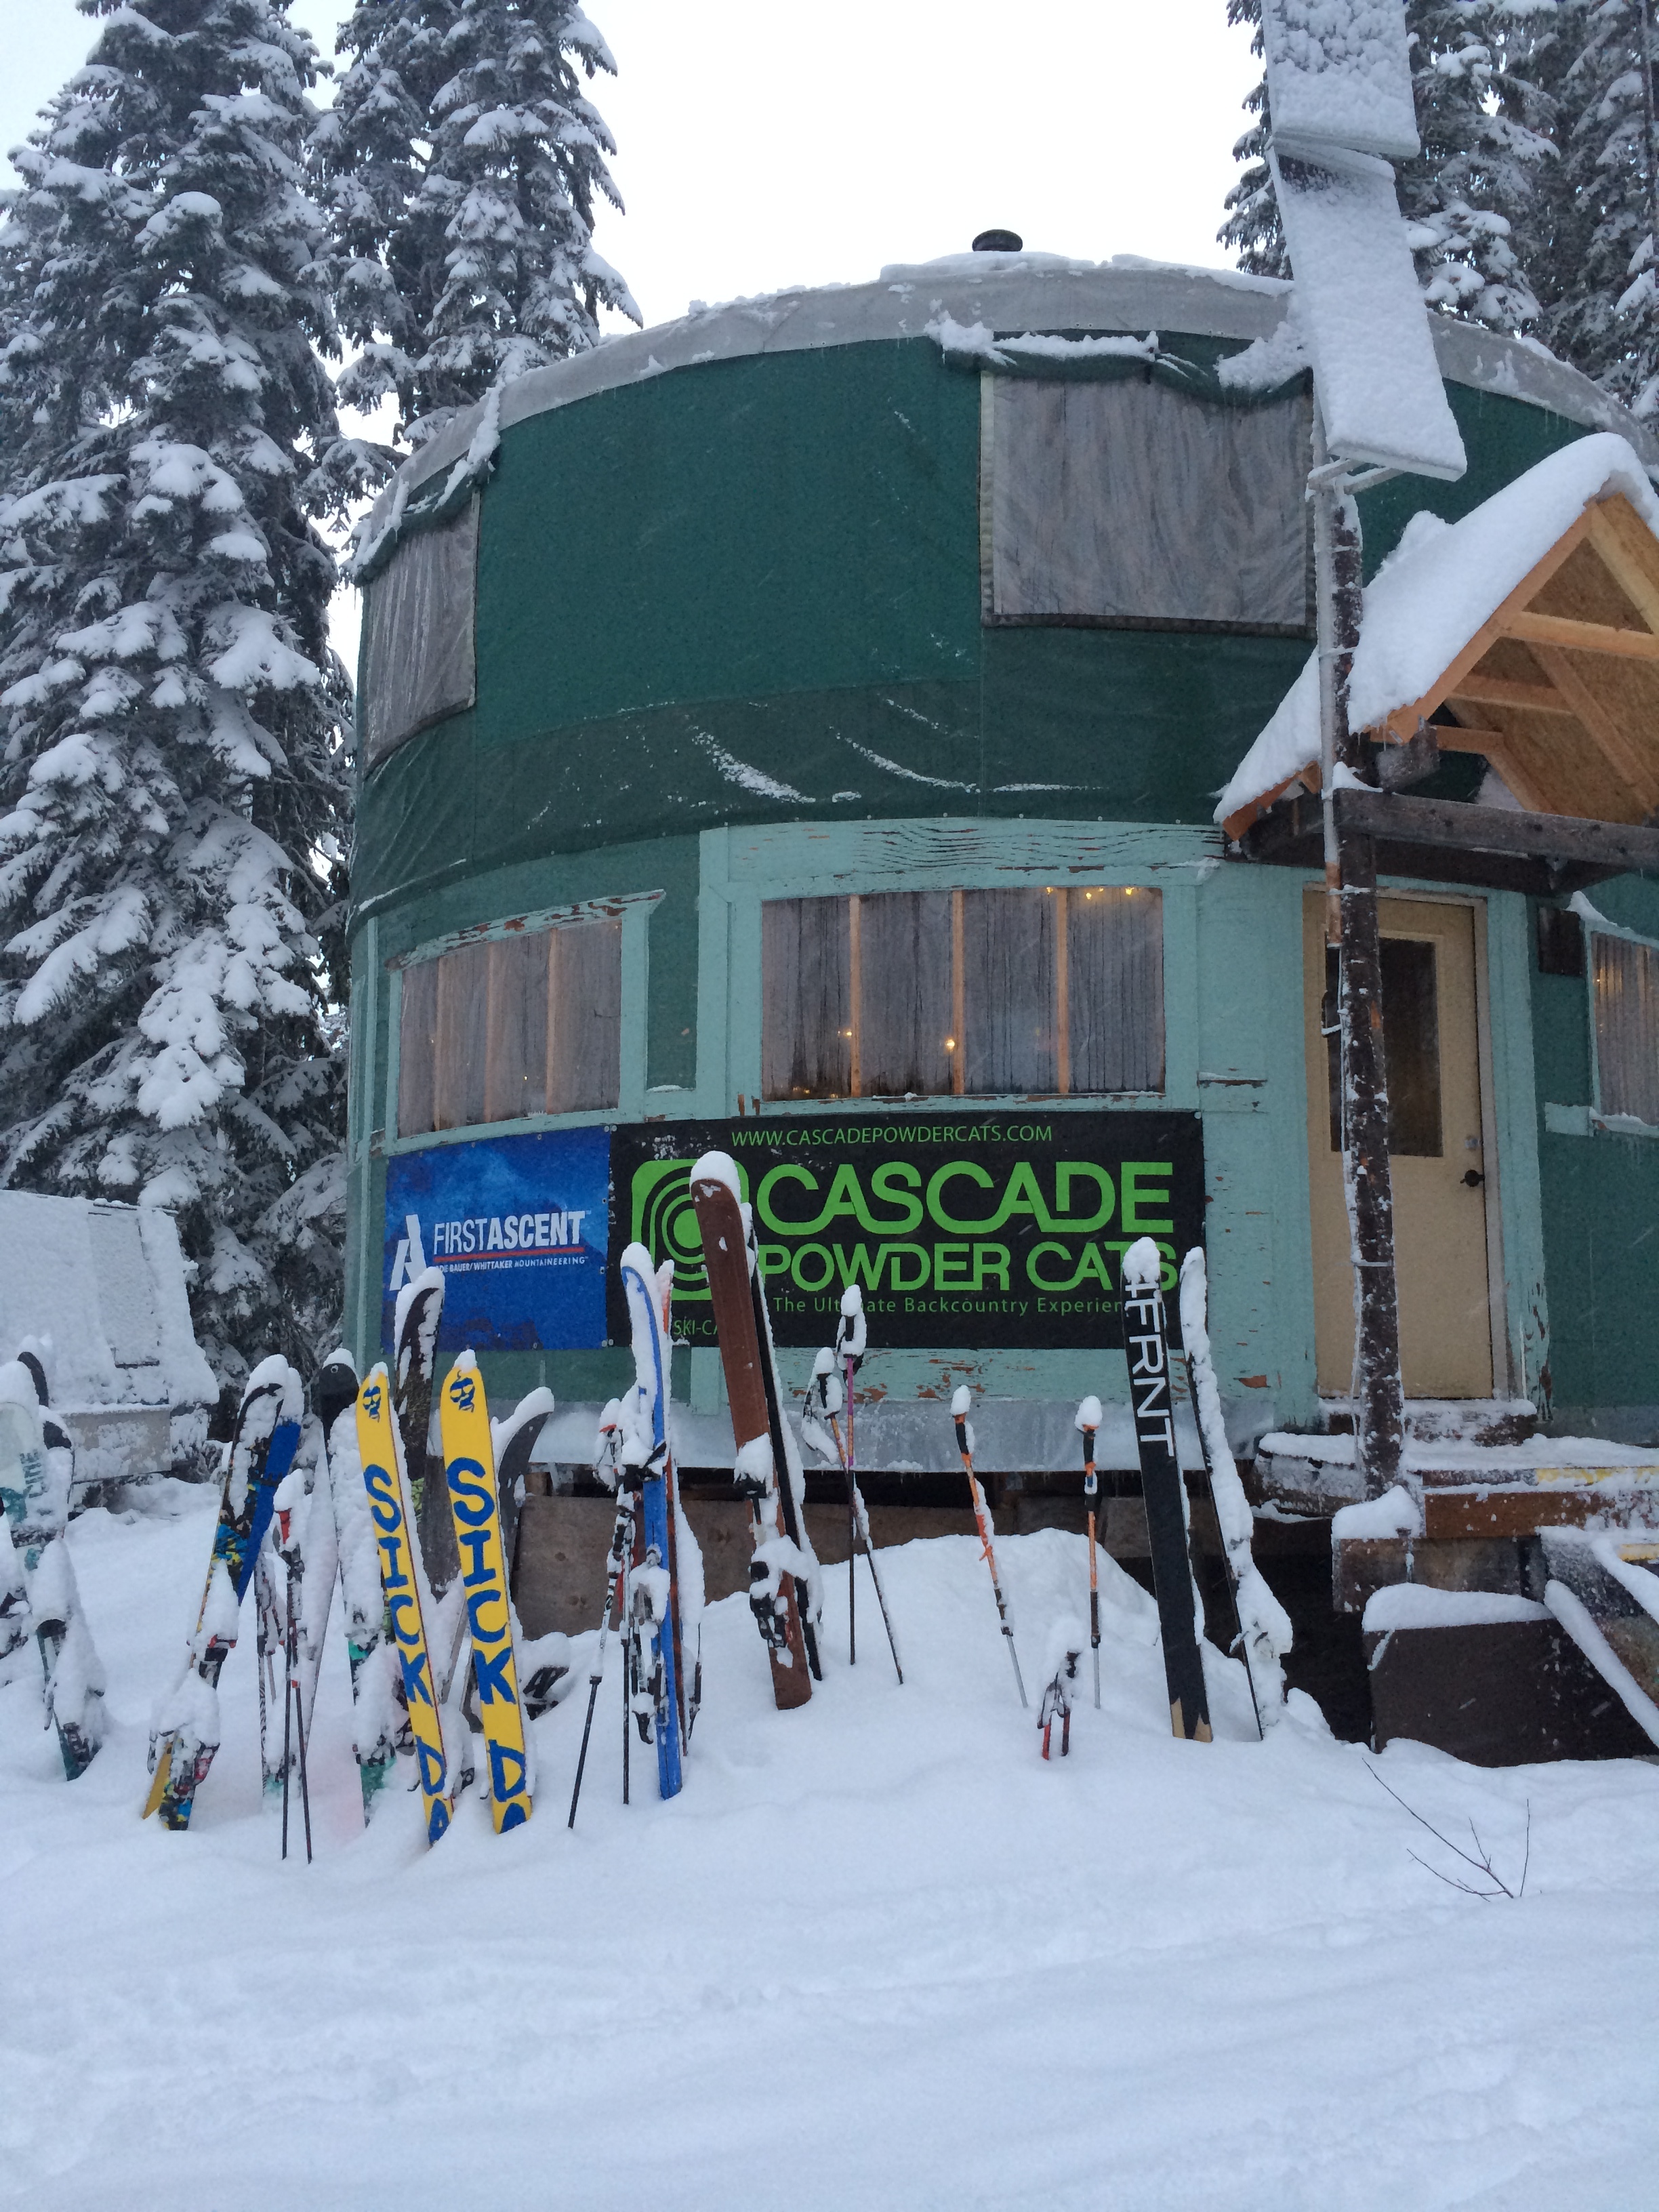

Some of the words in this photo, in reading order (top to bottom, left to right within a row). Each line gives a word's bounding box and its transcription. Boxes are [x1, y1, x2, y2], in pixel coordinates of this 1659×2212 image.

[731, 1125, 1052, 1147] WWW.CASCADEPOWDERCATS.COM
[756, 1160, 1174, 1236] CASCADE
[514, 1256, 586, 1268] MOUNTAINEERING
[757, 1242, 1010, 1292] POWDER
[773, 1297, 806, 1312] The
[814, 1296, 897, 1313] Ultate
[904, 1296, 1029, 1317] Backcountry
[1037, 1296, 1122, 1317] Experien
[363, 1463, 434, 1708] SICK
[446, 1456, 518, 1705] SICK
